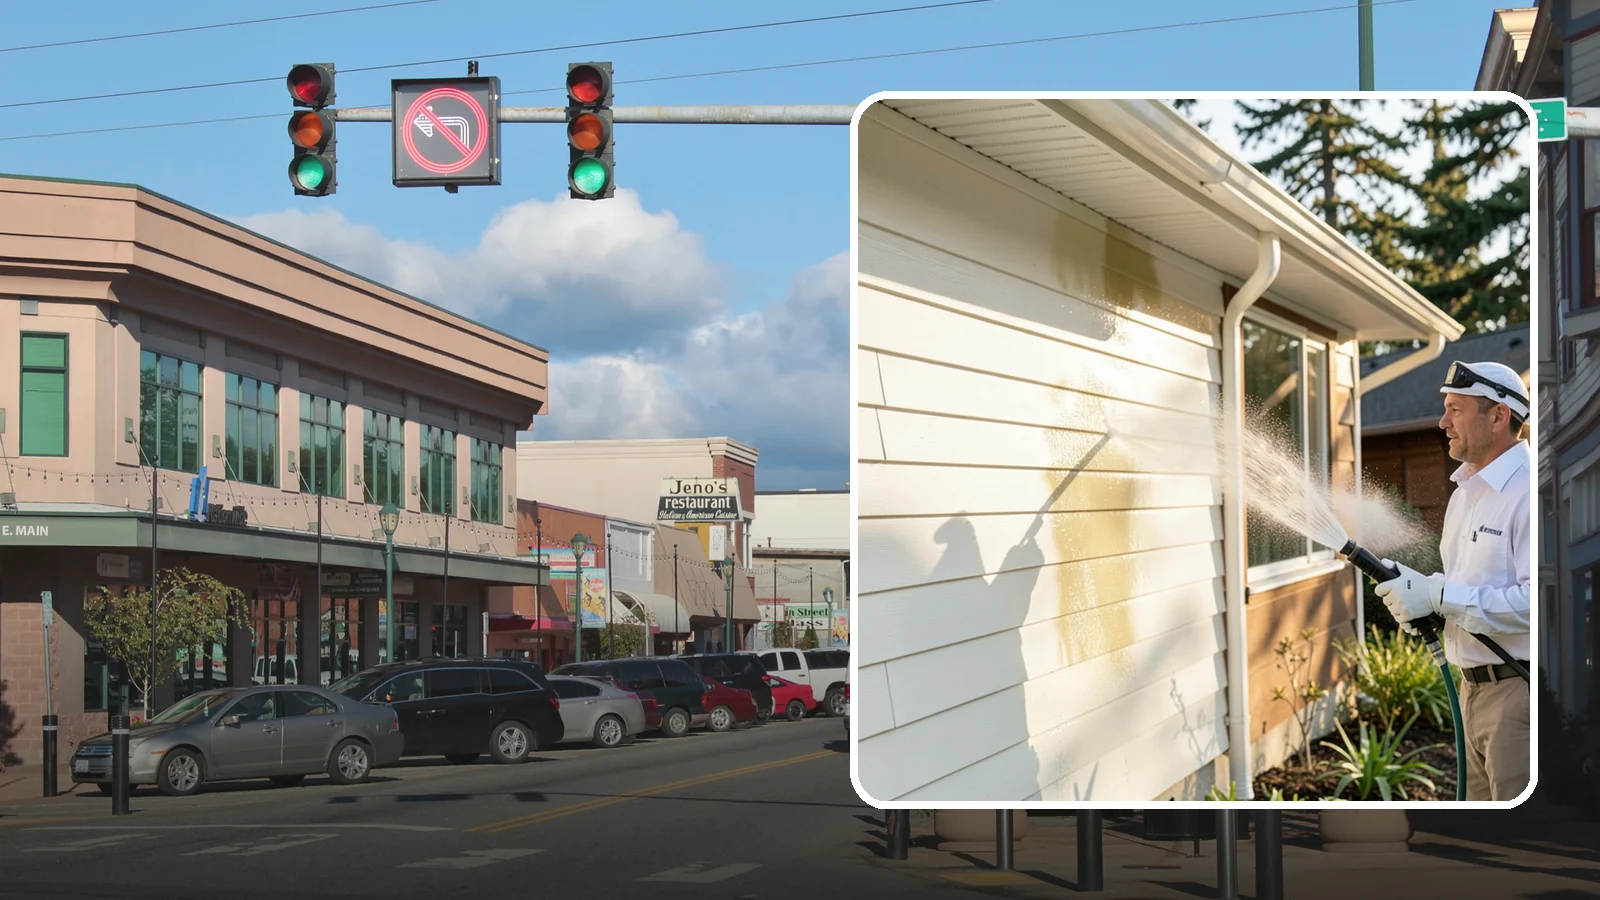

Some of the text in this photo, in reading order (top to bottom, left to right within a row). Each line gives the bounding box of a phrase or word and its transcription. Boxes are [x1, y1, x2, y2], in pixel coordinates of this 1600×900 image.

[669, 480, 727, 494] Jeno's
[665, 496, 731, 509] restaurant
[659, 510, 682, 519] Italian
[686, 509, 714, 519] American
[715, 509, 738, 519] Cuisine
[2, 525, 49, 536] E. MAIN
[797, 607, 829, 617] Street
[791, 619, 824, 627] lass
